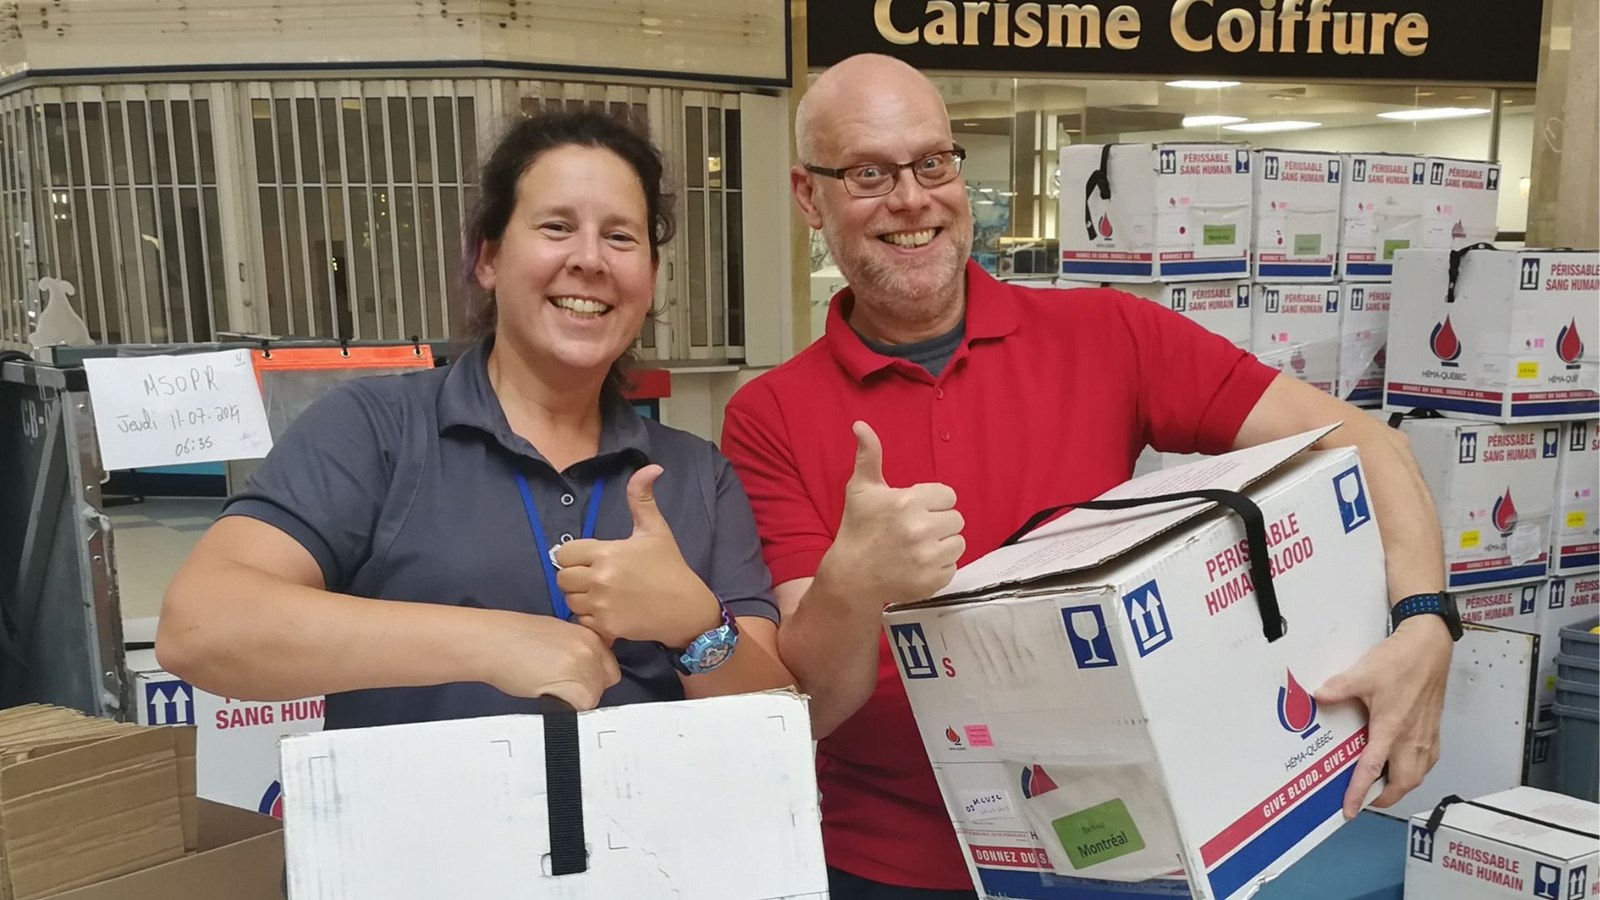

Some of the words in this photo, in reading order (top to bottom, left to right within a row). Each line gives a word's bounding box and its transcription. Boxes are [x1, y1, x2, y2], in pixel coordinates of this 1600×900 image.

[873, 0, 1141, 50] Carisme
[1169, 0, 1429, 57] Coiffure
[1183, 151, 1229, 163] PÉRISSABLE
[1180, 165, 1201, 175] SANG
[1203, 164, 1232, 175] HUMAIN
[1284, 160, 1323, 172] PÉRISSABLE
[1448, 167, 1483, 179] PÉRISSABLE
[1281, 172, 1299, 182] SANG
[1300, 173, 1325, 183] HUMAIN
[1367, 174, 1384, 184] SANG
[1386, 176, 1410, 185] HUMAIN
[1444, 178, 1461, 188] SANG
[1462, 179, 1484, 190] HUMAIN
[1551, 262, 1600, 276] PÉRISSABLE
[1545, 279, 1569, 291] SANG
[1191, 287, 1231, 299] PÉRISSABLE
[1188, 301, 1207, 311] SANG
[1208, 300, 1234, 311] HUMAIN
[1281, 304, 1298, 314] SANG
[1300, 304, 1323, 314] HUMAIN
[143, 365, 220, 397] MSOPR
[1487, 432, 1535, 448] PÉRISSABLE
[1483, 450, 1504, 463] SANG
[1506, 448, 1536, 461] HUMAIN
[1205, 512, 1300, 583] PERISABLE
[1204, 568, 1256, 616] HUMA
[1269, 535, 1314, 580] BLOOD
[1465, 592, 1513, 610] PÉRISSABLE
[1570, 594, 1593, 607] SANG
[1461, 609, 1483, 623] SANG
[1484, 606, 1514, 622] HUMAIN
[215, 705, 273, 730] SANG
[1284, 730, 1334, 771] HÉMA-QUÉBEC
[1263, 793, 1287, 818] GIVE
[1288, 768, 1323, 800] BLOOD.
[1323, 751, 1345, 773] GIVE
[1077, 830, 1129, 858] Montréal
[975, 849, 1018, 863] DONNEZ
[1020, 852, 1035, 864] DU
[1448, 841, 1520, 874] PÉRISSABLE
[1442, 856, 1473, 876] SANG
[1476, 866, 1523, 891] HUMAIN
